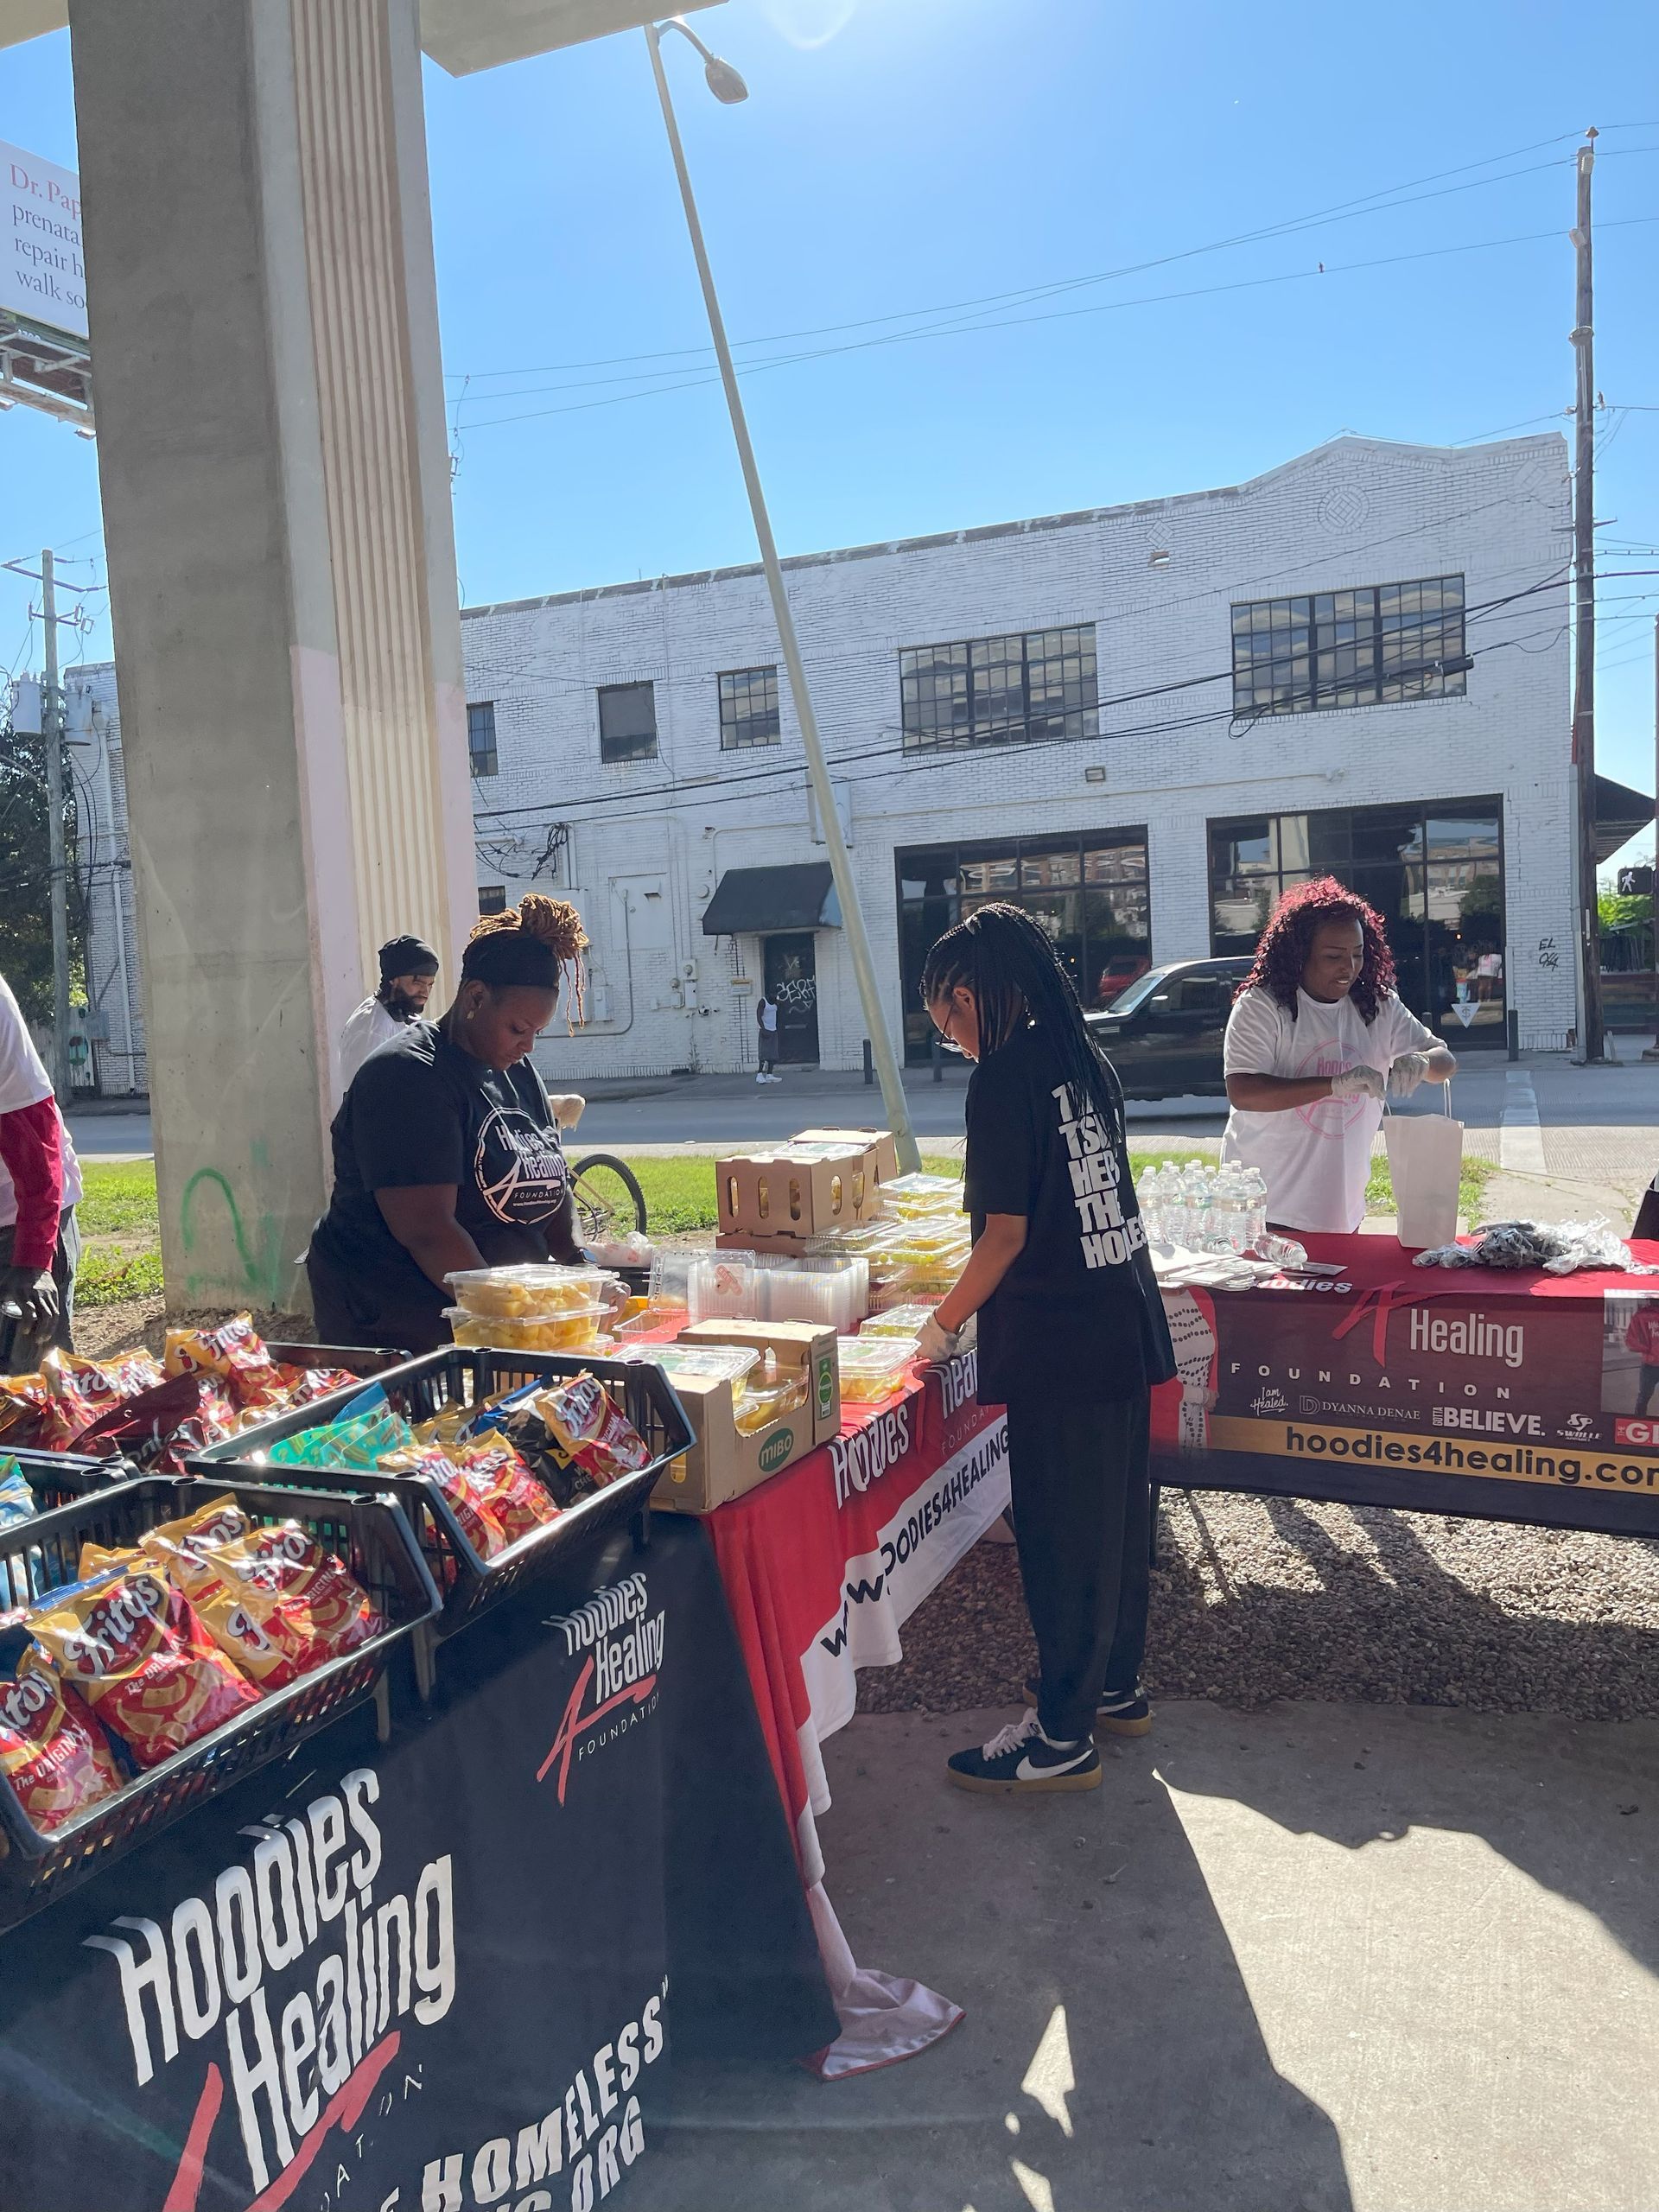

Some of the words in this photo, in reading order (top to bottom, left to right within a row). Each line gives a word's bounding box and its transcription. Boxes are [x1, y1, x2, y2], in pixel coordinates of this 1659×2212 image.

[10, 162, 43, 199] Dr.
[12, 204, 84, 247] prenata
[15, 236, 67, 270] repair
[16, 269, 62, 302] walk
[1410, 1308, 1524, 1368] Healing
[1230, 1363, 1510, 1400] FOUNDATION
[1322, 1402, 1374, 1415] DYANNA
[1377, 1404, 1421, 1420] DENAE
[1433, 1407, 1444, 1427] GOTTA
[1444, 1407, 1546, 1436] BELIEVE.
[64, 1577, 161, 1676] Fritos
[541, 1572, 648, 1656] Hoodies
[595, 1610, 665, 1705] Healing
[14, 1774, 35, 1791] The
[81, 1768, 383, 2086] Hoodies
[226, 1854, 455, 2195] Healing
